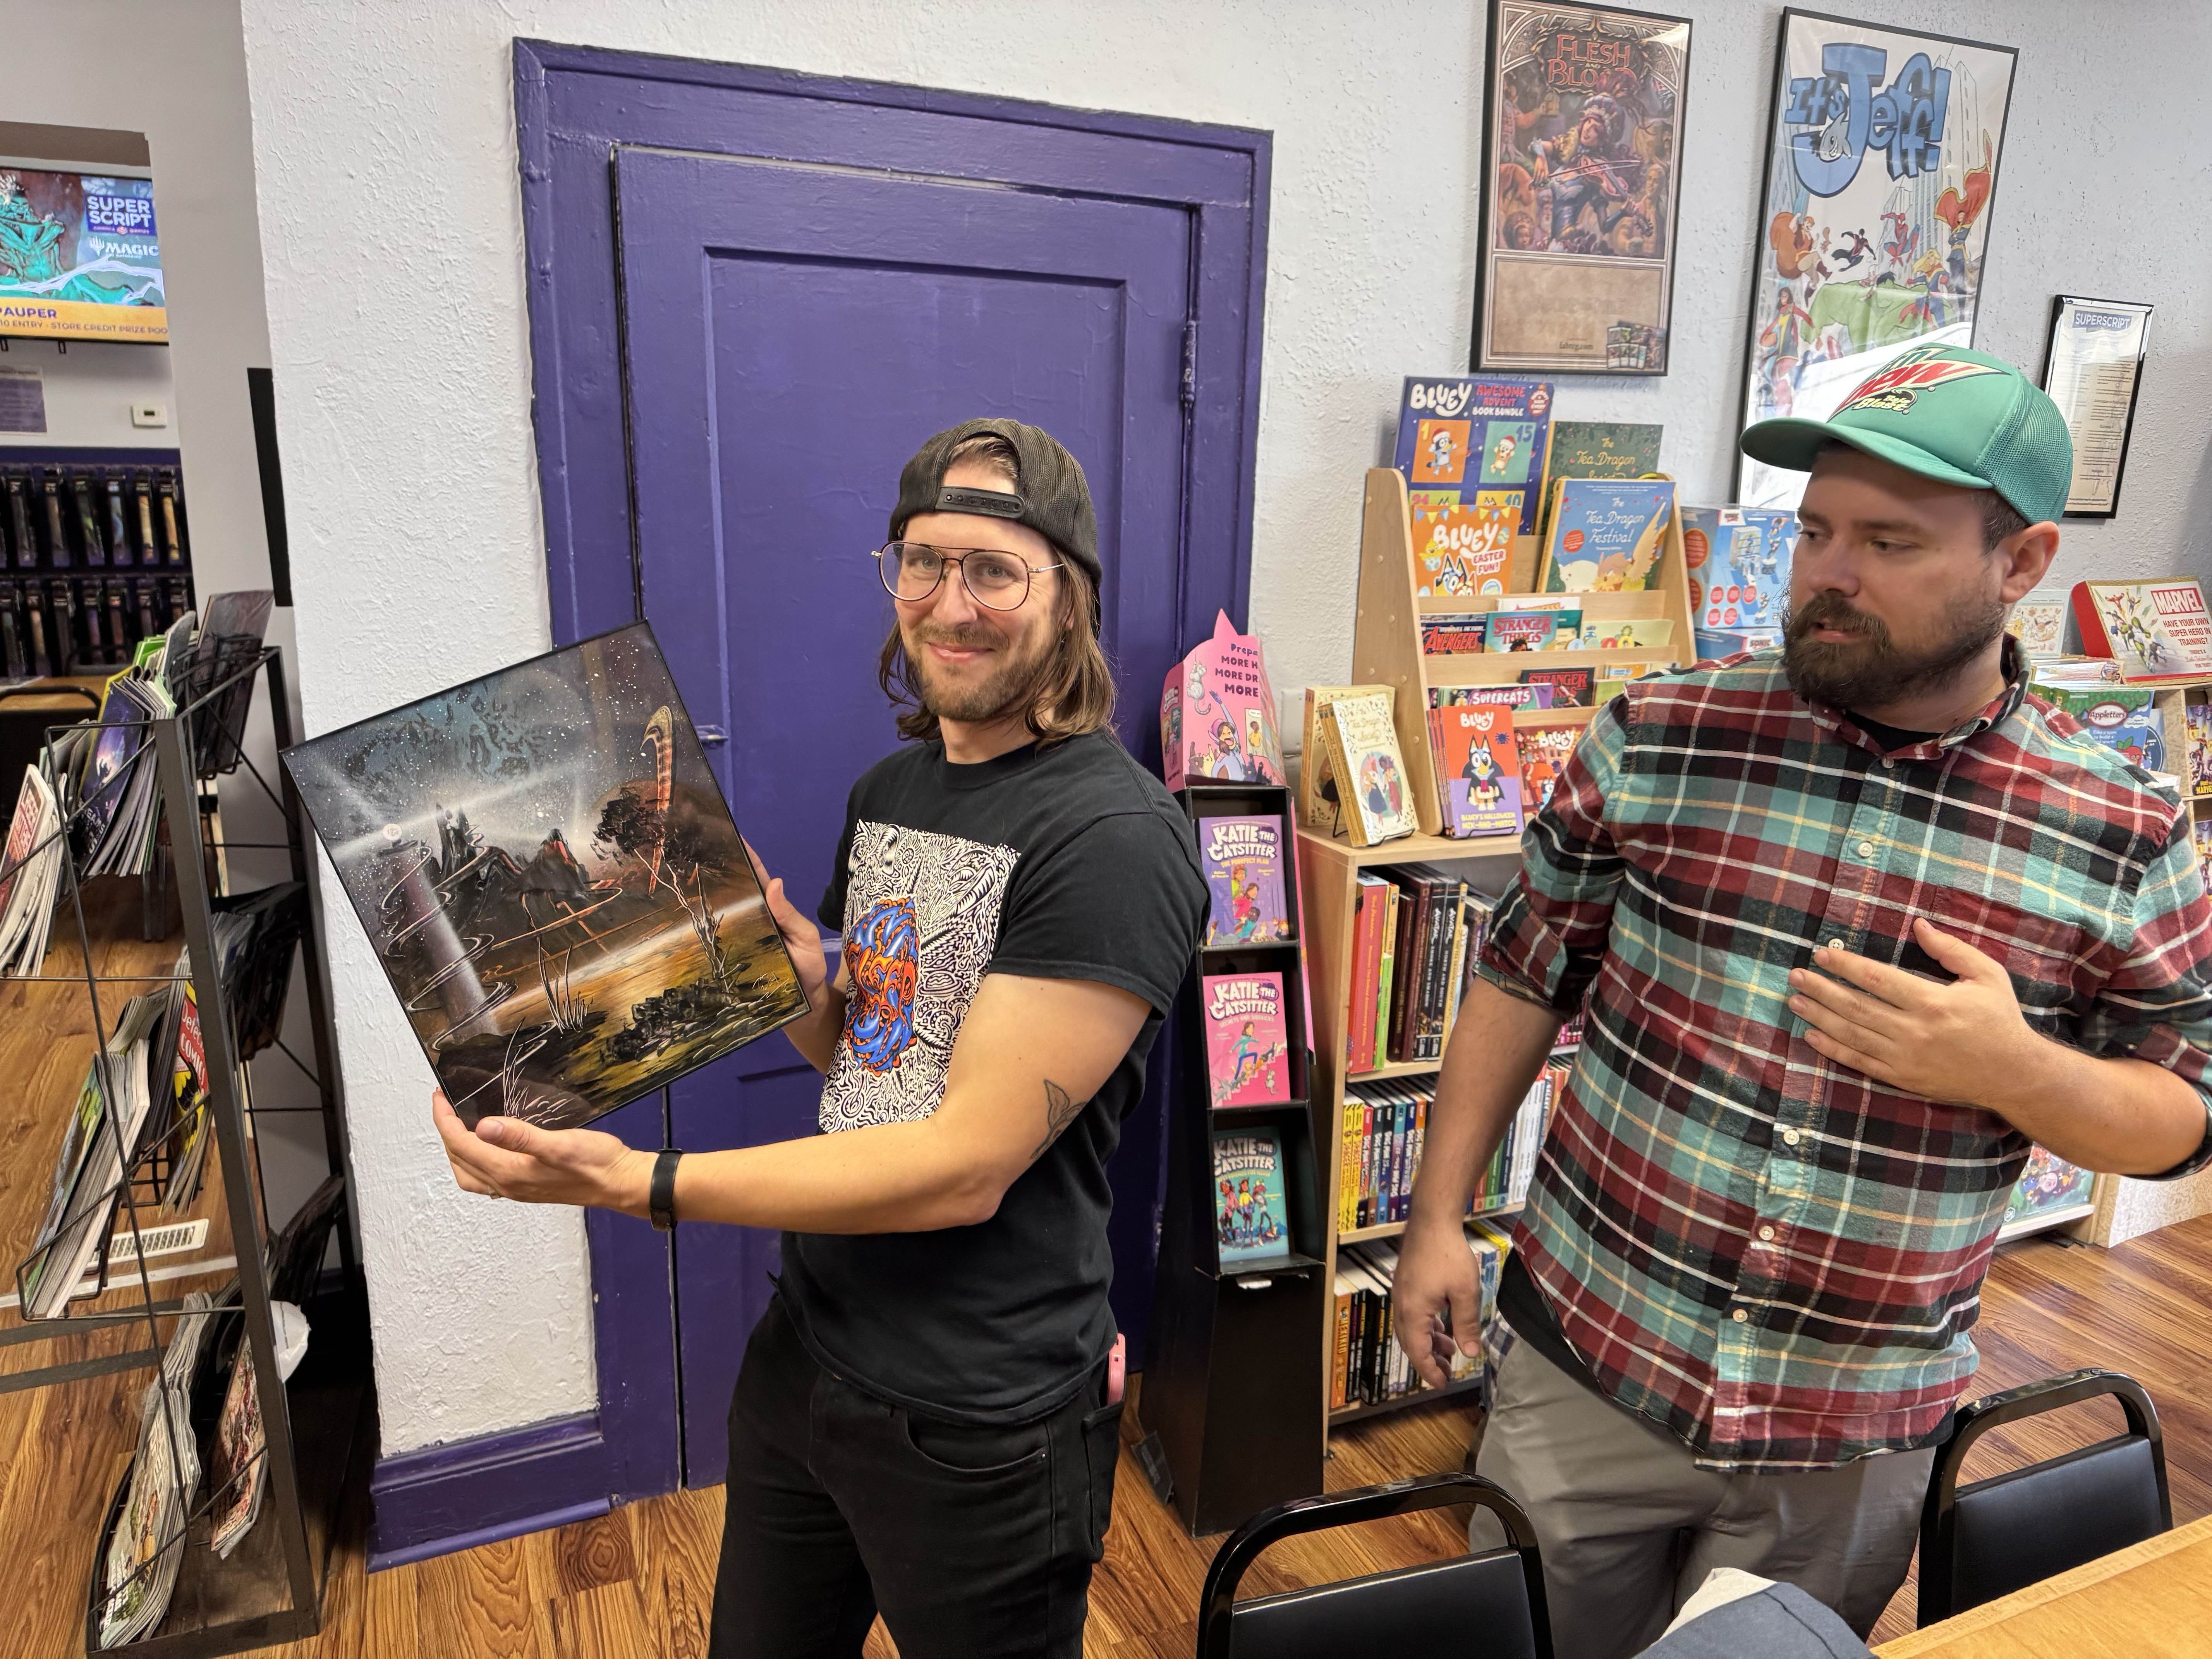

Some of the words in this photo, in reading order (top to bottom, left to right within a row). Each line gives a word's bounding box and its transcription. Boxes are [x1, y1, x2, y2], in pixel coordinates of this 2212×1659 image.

[1556, 34, 1630, 68] FLESH
[1784, 77, 1851, 124] It's
[1793, 42, 1952, 198] Jeff!
[87, 196, 150, 213] SUPER
[89, 211, 151, 227] SCRIPT
[105, 242, 159, 256] MAGIC
[0, 306, 57, 319] AUPER
[2075, 313, 2130, 330] SUPERSCRIPT
[1410, 382, 1472, 417] BLUEY
[1477, 385, 1526, 397] AWESOME
[1482, 397, 1516, 407] ADVENT
[1853, 398, 1909, 410] Blast
[1883, 395, 1911, 405] Baja
[1472, 406, 1494, 416] BOOK
[1495, 407, 1524, 416] BUNDLE
[1516, 425, 1532, 442] 15
[1577, 450, 1593, 465] Tea
[1594, 451, 1635, 469] Dragon
[1586, 510, 1603, 524] Tea
[1604, 511, 1645, 529] Dragon
[1433, 522, 1499, 558] BLUEY
[1589, 526, 1635, 543] Festival
[1474, 551, 1504, 563] EASTER
[2152, 590, 2203, 613] MARVEL
[1493, 616, 1551, 636] STRANGER
[2169, 629, 2188, 637] SUPER
[1422, 626, 1481, 655] AVENGERS
[1221, 656, 1248, 668] MORE
[1215, 668, 1242, 680] MORE
[1246, 673, 1258, 682] DR
[1224, 684, 1259, 697] MORE
[1472, 689, 1531, 705] SUPERCATS
[1460, 711, 1494, 731] BLUEY
[2091, 710, 2125, 720] Appletters
[1538, 730, 1574, 750] BLUEY
[1213, 825, 1259, 845] KATIE
[1259, 831, 1275, 841] THE
[1207, 842, 1276, 860] CATSITTER
[1430, 907, 1442, 945] AVATAR
[1445, 907, 1457, 945] AVATAR
[1214, 982, 1260, 1003] KATIE
[1261, 988, 1276, 998] THE
[1208, 1000, 1277, 1019] CATSITTER
[1214, 1137, 1256, 1159] KATIE
[1259, 1143, 1273, 1152] THE
